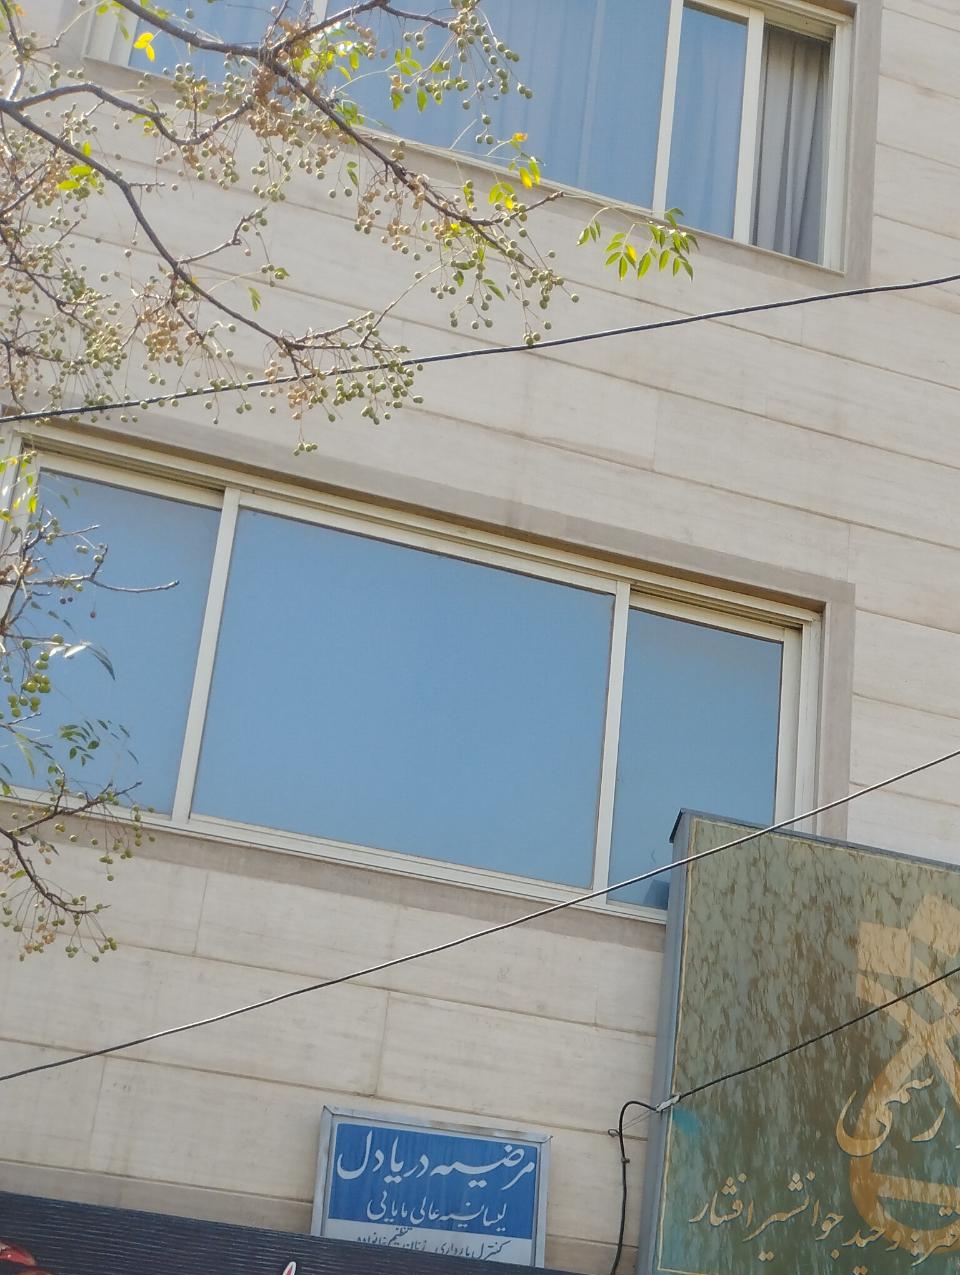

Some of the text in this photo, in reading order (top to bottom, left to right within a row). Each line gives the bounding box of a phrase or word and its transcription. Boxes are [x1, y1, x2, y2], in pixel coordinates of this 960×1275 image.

[836, 1074, 946, 1157] رسمی
[430, 1144, 536, 1191] مرضیه
[410, 1195, 440, 1225] عالی
[688, 1172, 754, 1228] افشار
